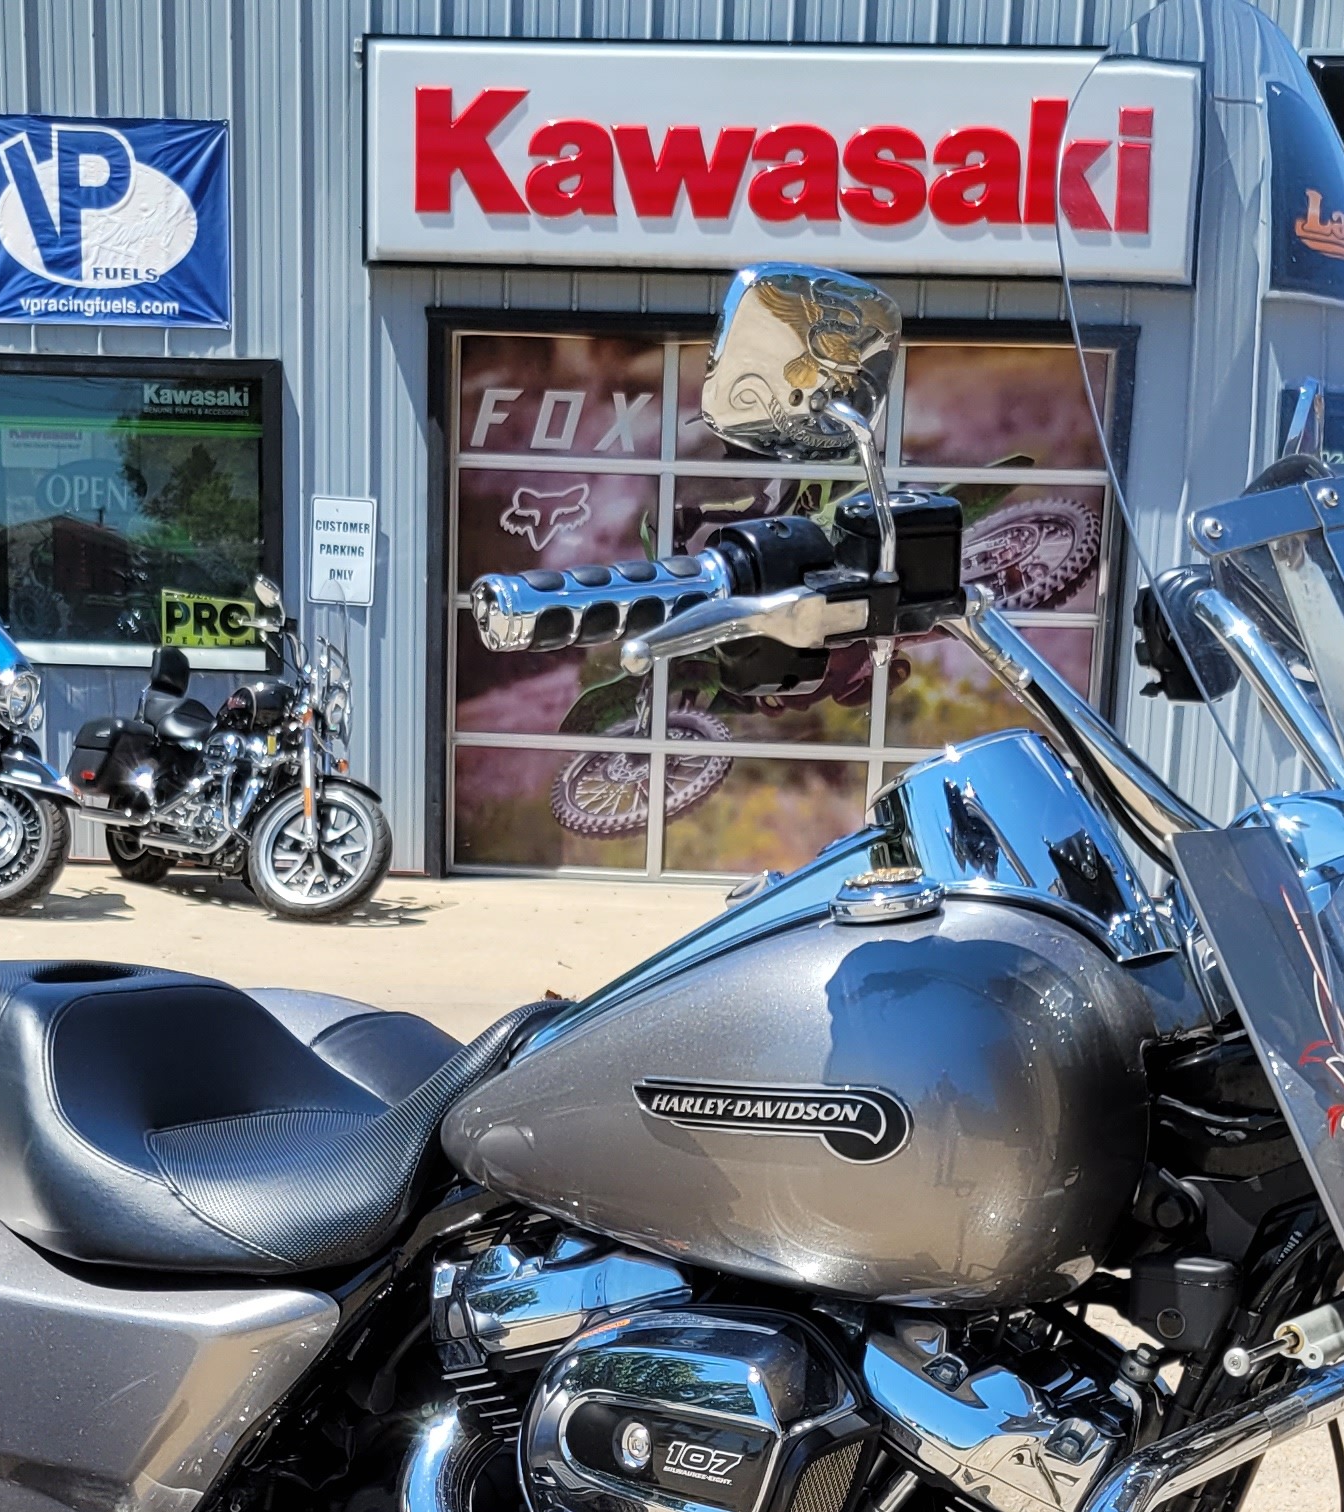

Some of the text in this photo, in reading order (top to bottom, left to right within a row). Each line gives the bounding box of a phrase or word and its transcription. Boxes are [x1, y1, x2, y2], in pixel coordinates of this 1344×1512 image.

[414, 85, 1155, 233] Kawasaki
[92, 267, 159, 281] FUELS
[20, 296, 179, 315] vpracingfuels.com
[143, 383, 249, 406] Kawasaki
[175, 407, 196, 415] PARTS
[205, 408, 249, 417] ACCESSORIES
[470, 389, 656, 451] FOX
[46, 474, 128, 511] OPEN
[316, 520, 370, 534] CUSTOMER
[320, 544, 365, 557] PARKING
[329, 569, 354, 580] ONLY
[166, 601, 251, 637] PRO
[651, 1094, 862, 1122] HARLEY-DAVIDSON
[666, 1441, 744, 1475] 107
